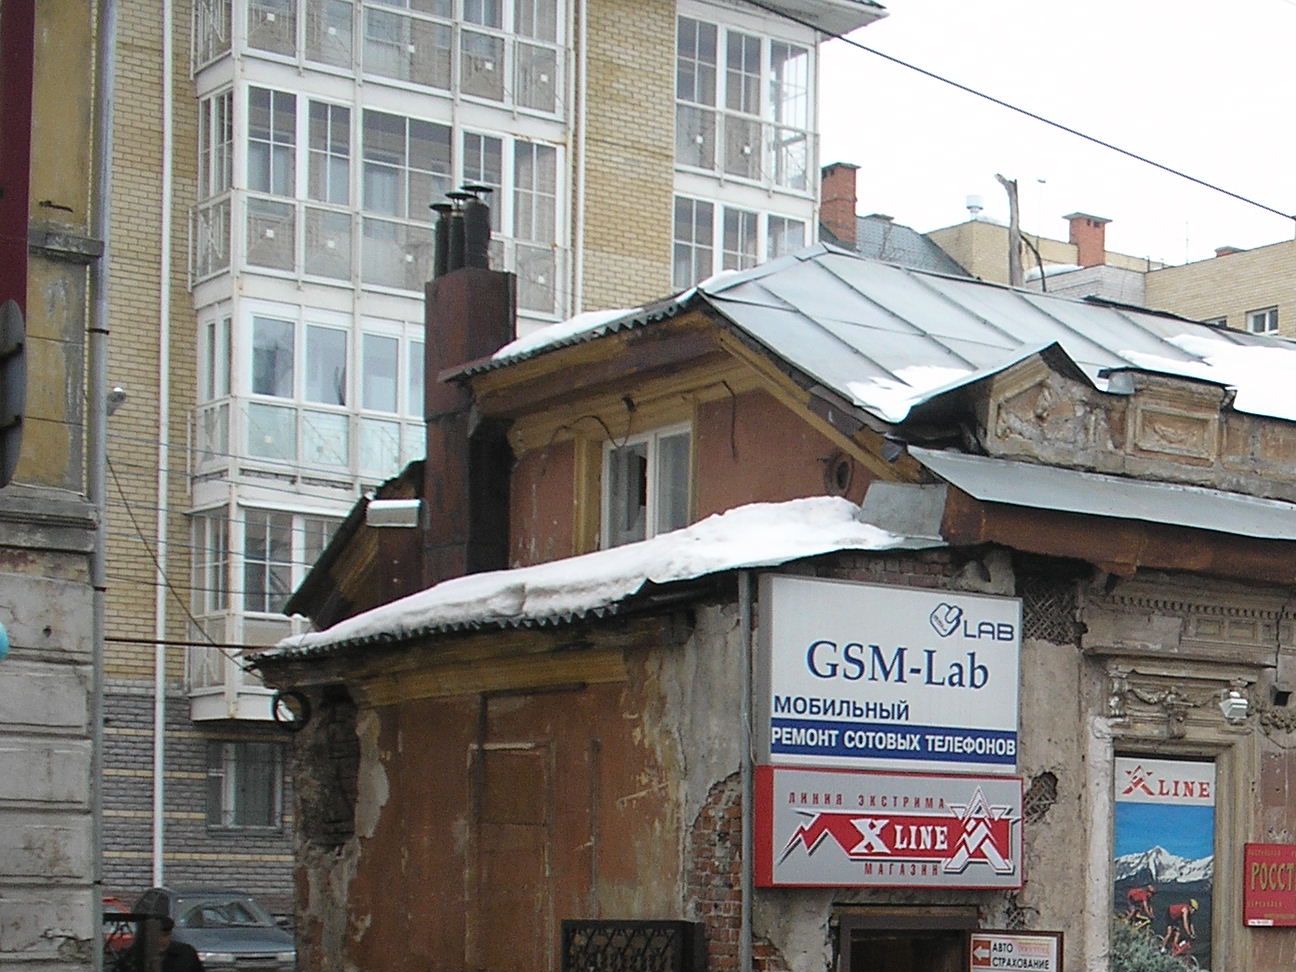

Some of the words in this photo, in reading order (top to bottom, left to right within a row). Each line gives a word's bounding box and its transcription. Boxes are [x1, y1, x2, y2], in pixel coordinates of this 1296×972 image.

[964, 620, 1014, 641] LAB
[805, 640, 990, 689] GSM-Lab
[774, 695, 909, 721] МОБИЛЬНЫЙ
[771, 726, 839, 747] РЕМОНТ
[843, 730, 921, 752] СОТОВЫХ
[926, 735, 1016, 756] ТЕЛЕФОНОВ
[788, 792, 842, 805] ЛИНИЯ
[858, 795, 945, 809] ЭКСТРИМА
[850, 818, 892, 854] X
[894, 825, 948, 850] LINE
[864, 863, 939, 876] МАГАЗИН
[992, 943, 1013, 953] АВТО
[992, 957, 1049, 970] СТРАХОВАНИЕ
